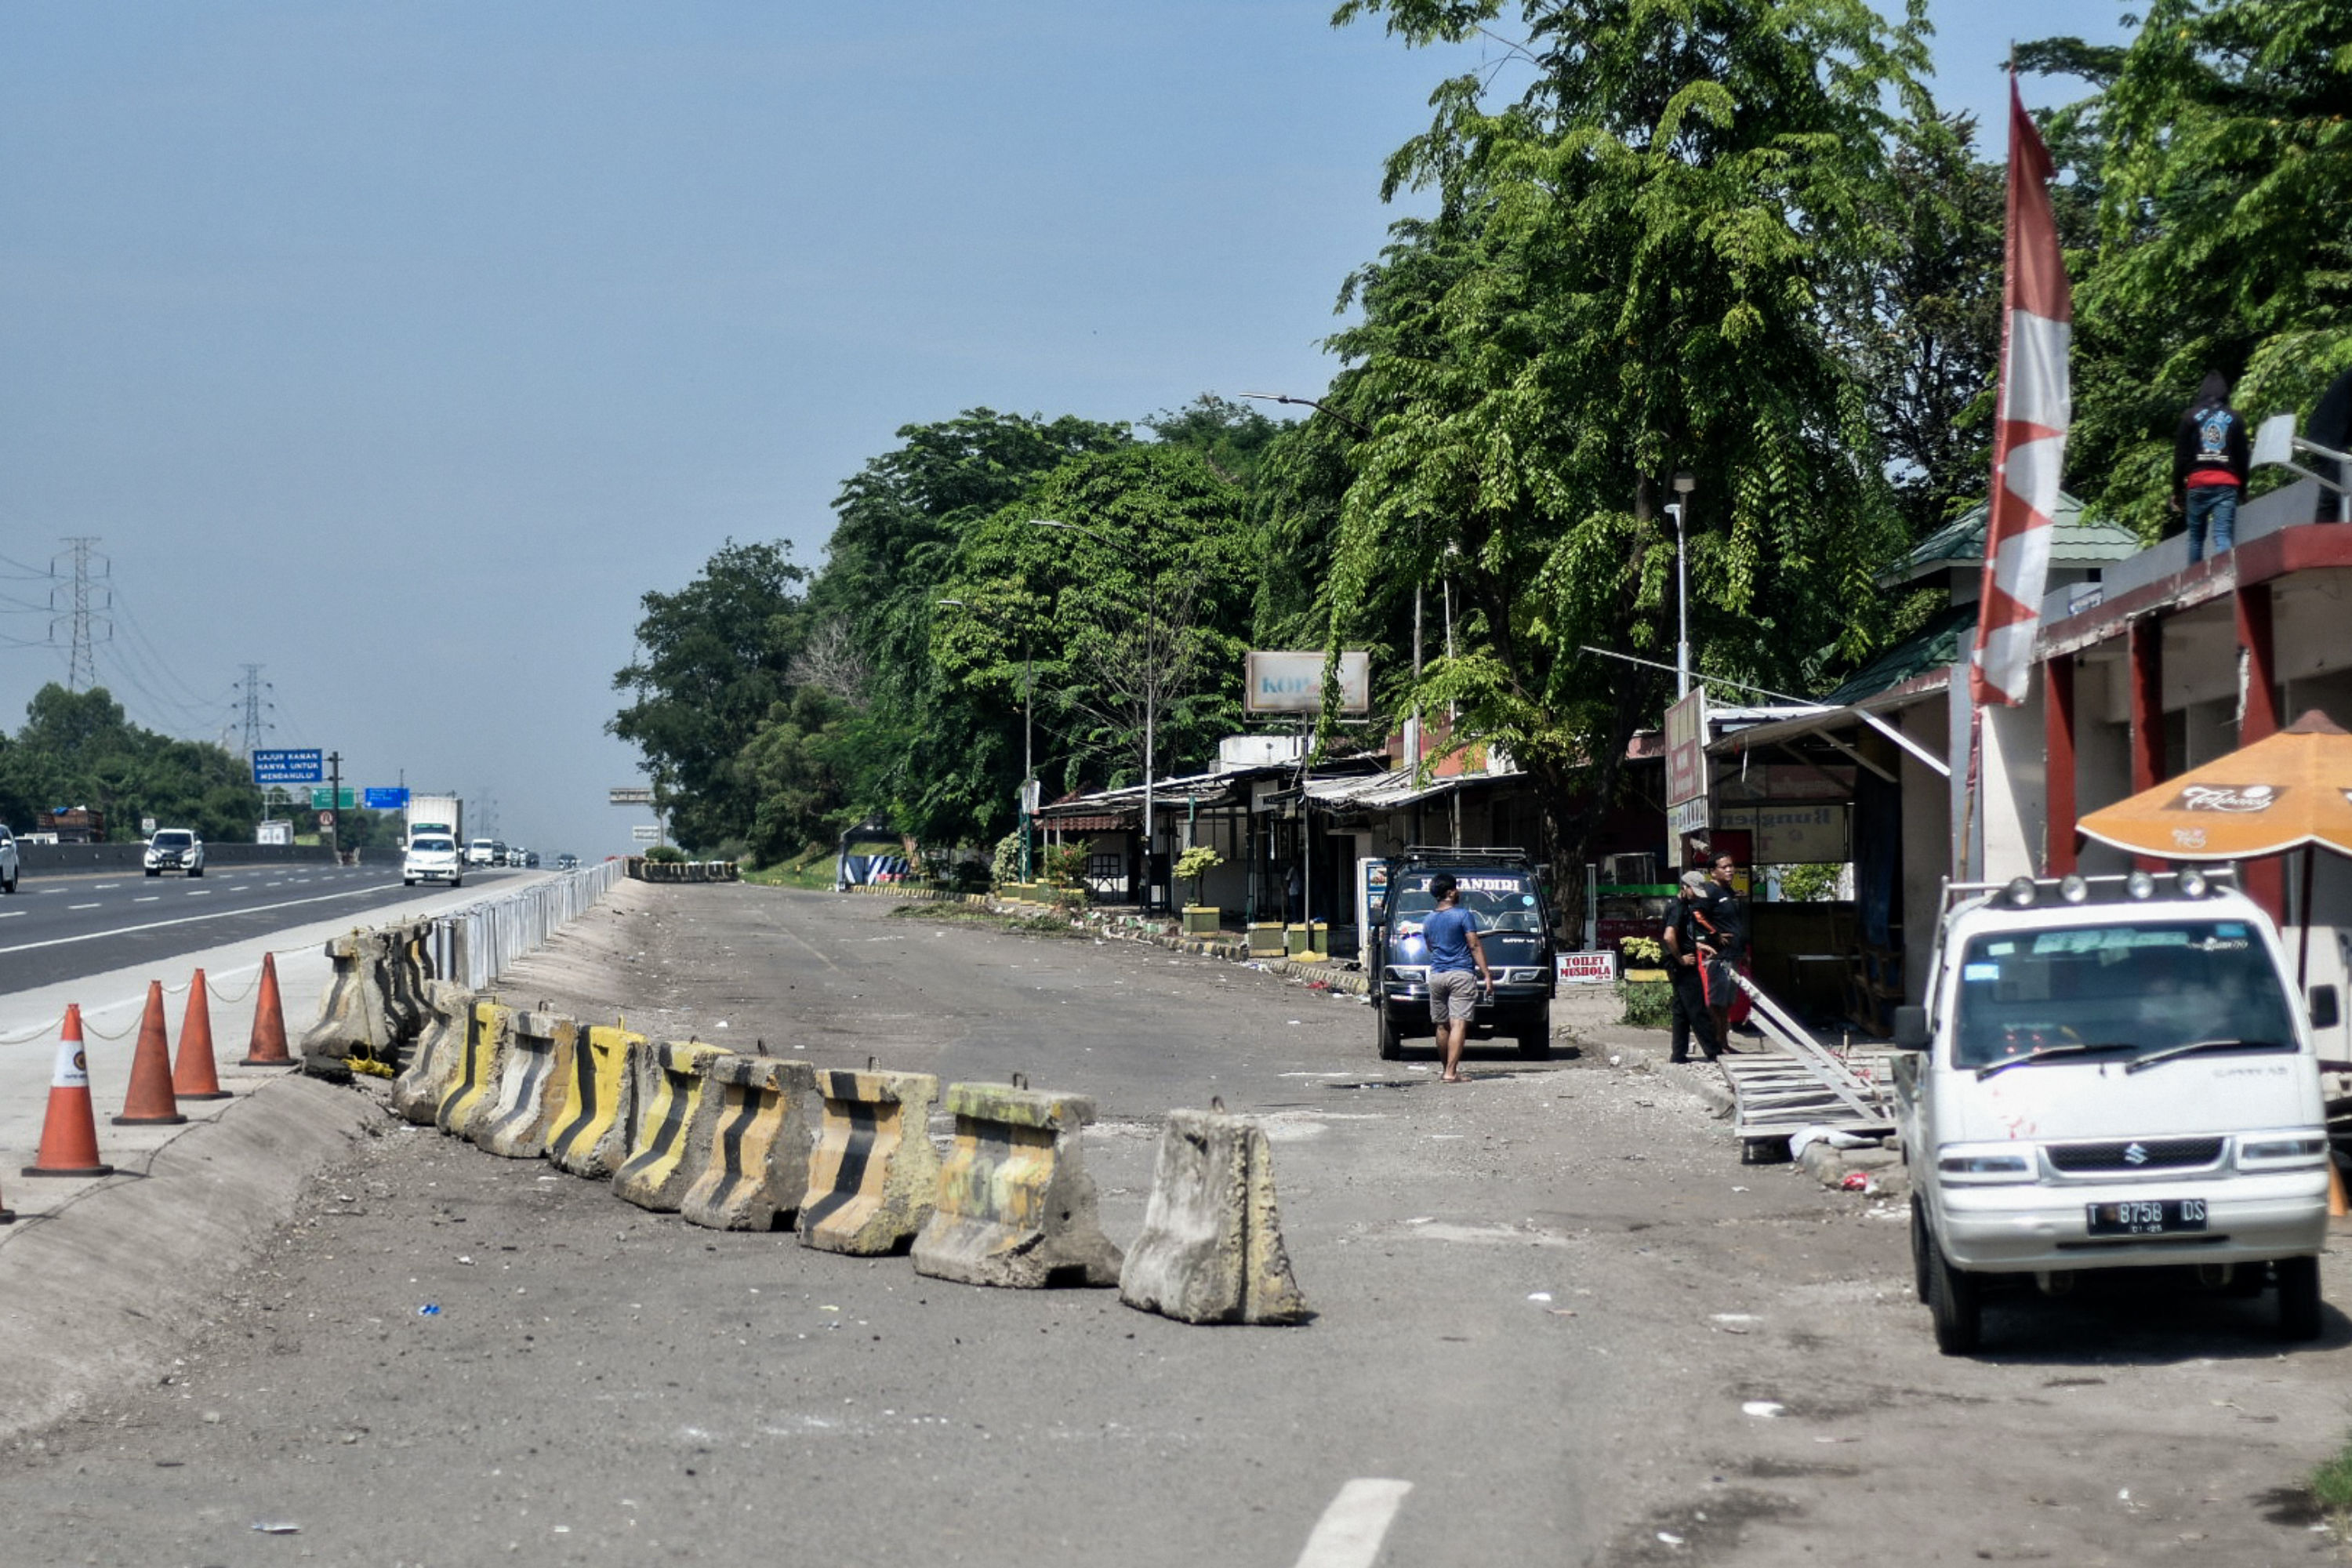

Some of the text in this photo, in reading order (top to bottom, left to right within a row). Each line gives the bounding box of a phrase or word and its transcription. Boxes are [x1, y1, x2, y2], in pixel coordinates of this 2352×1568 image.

[260, 771, 315, 780] MENDAHULUI
[1565, 956, 1604, 967] TOILET
[1560, 965, 1610, 978] MUSHOLA
[2088, 1200, 2205, 1225] T 8758 DS
